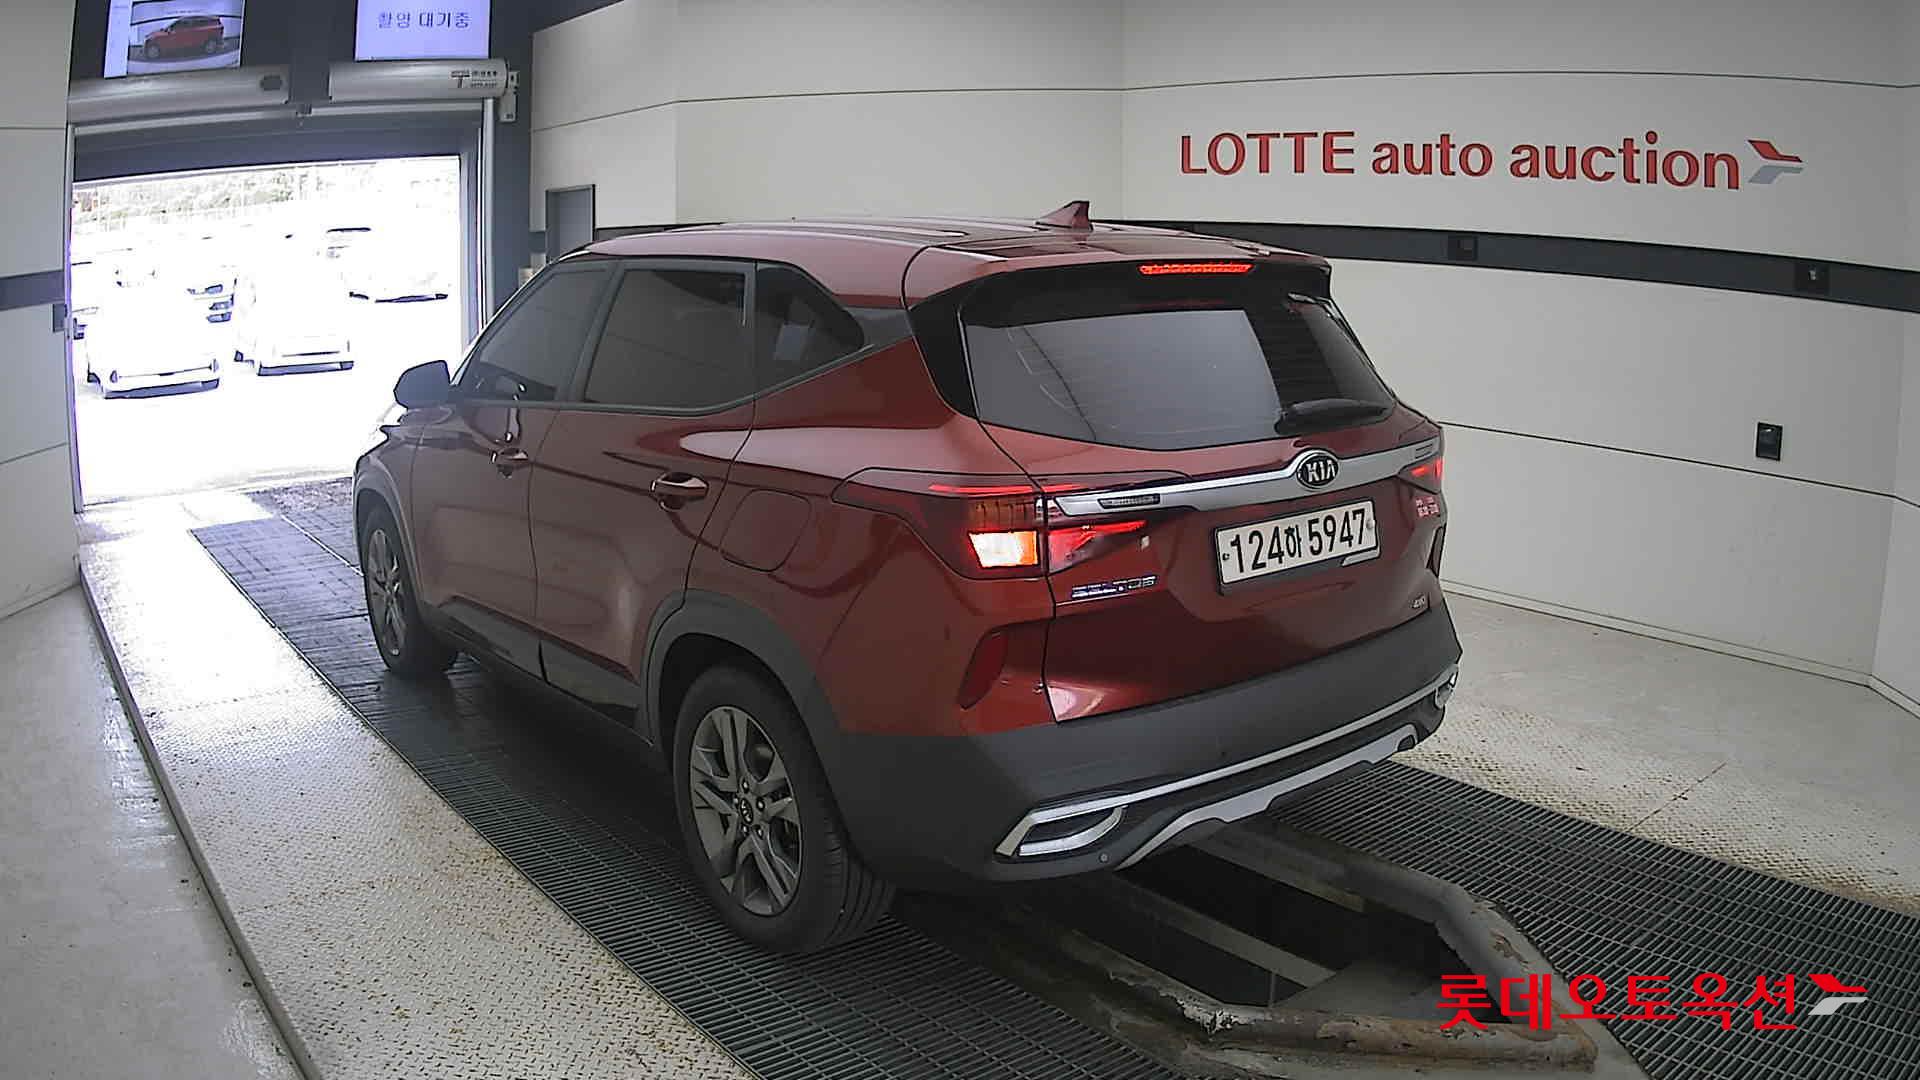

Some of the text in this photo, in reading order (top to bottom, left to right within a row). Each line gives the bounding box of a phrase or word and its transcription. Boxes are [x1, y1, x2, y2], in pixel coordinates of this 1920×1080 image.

[419, 12, 469, 29] 대기중
[1181, 130, 1740, 190] LOTTE auto auction
[1306, 459, 1336, 482] KIA
[1230, 508, 1366, 574] 124하 5947
